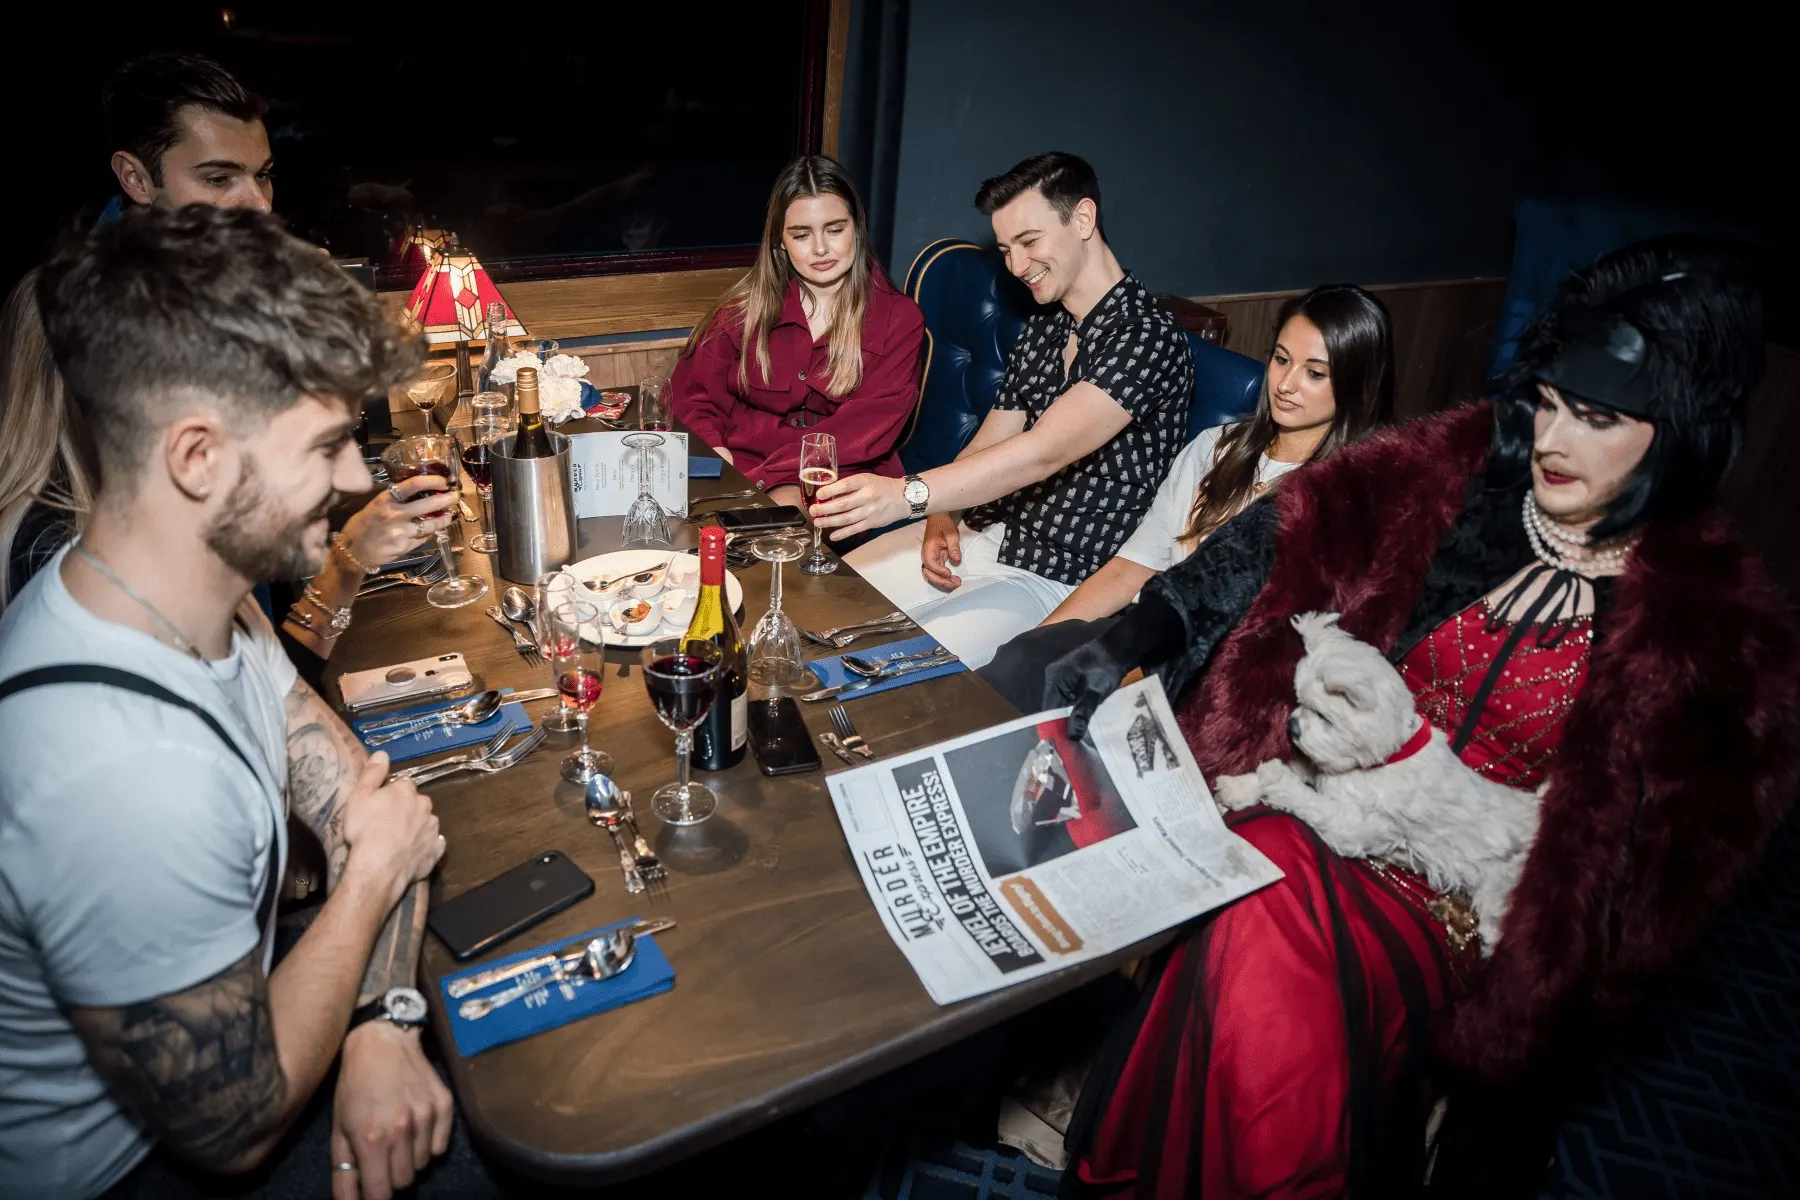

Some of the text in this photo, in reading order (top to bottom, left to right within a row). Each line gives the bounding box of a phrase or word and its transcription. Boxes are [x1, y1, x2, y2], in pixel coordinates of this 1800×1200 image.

[921, 770, 960, 839] EXPRESS!
[901, 784, 1012, 956] JEWEL OF THE EMPIRE
[905, 860, 940, 922] Express
[973, 893, 1000, 919] THE
[989, 914, 1035, 957] BOARDS
